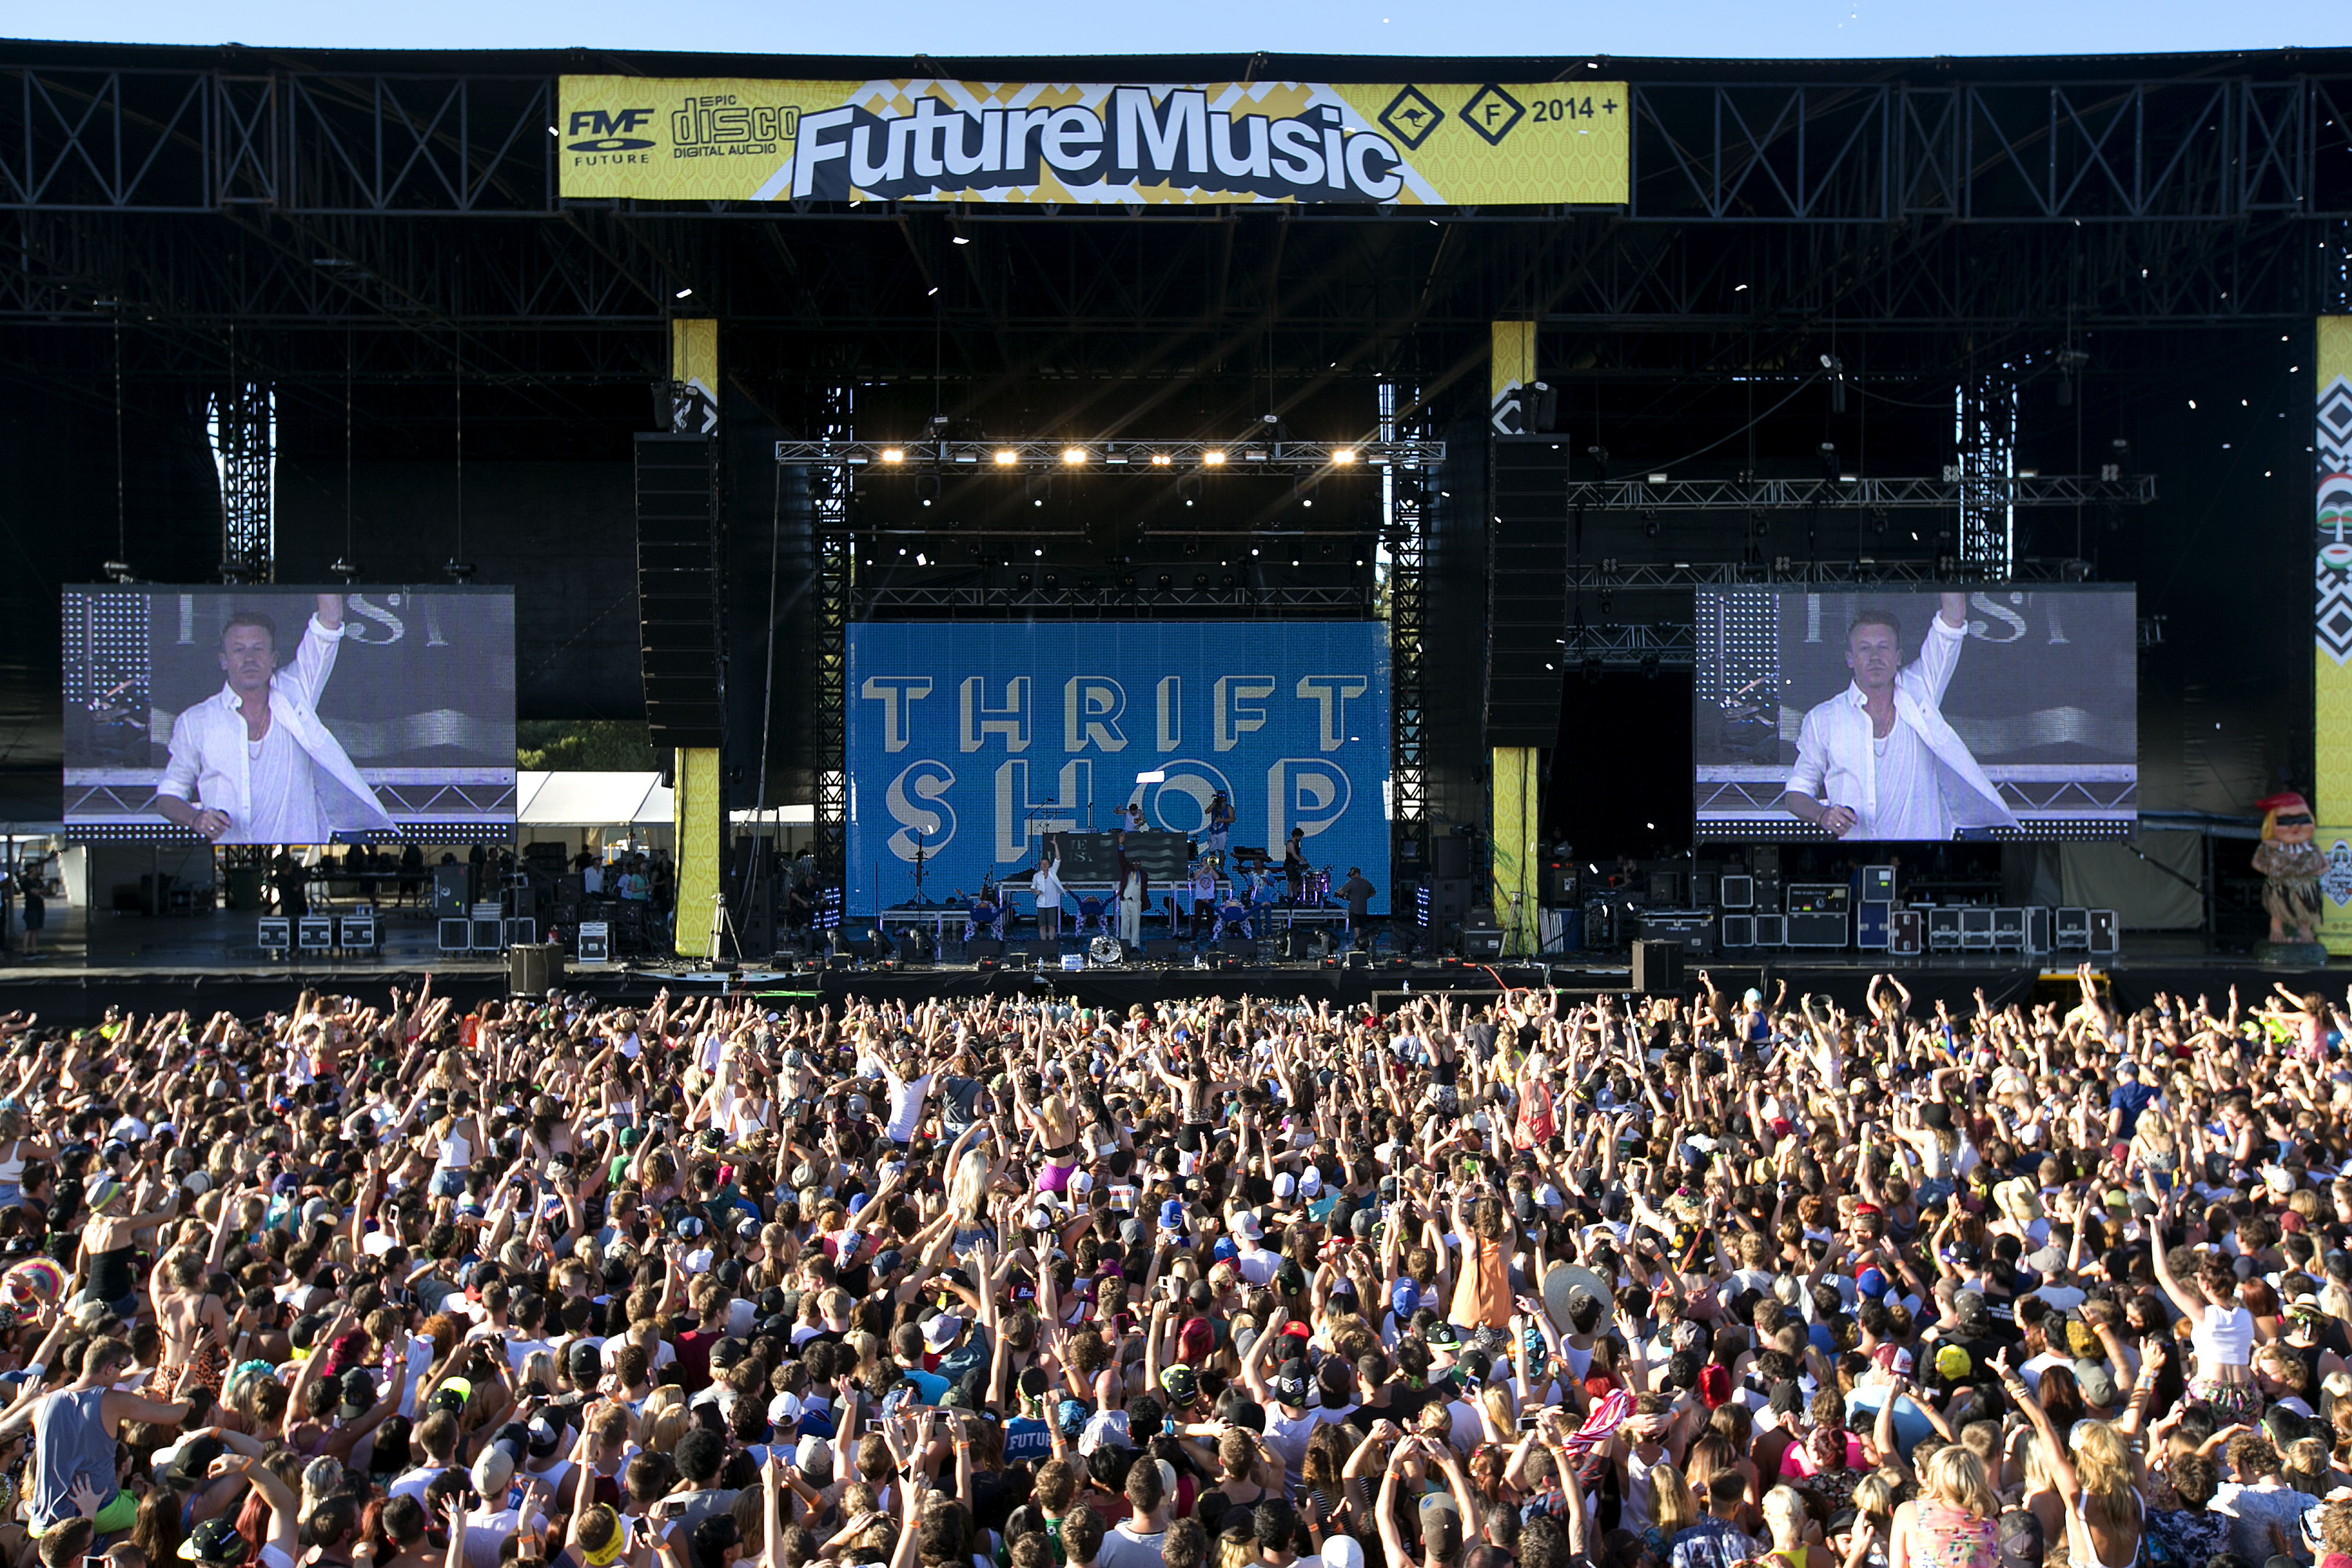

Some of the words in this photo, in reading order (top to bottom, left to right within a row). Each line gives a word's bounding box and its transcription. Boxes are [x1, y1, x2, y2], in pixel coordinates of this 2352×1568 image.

[700, 95, 736, 106] EPIC
[1532, 96, 1594, 122] 2014
[569, 109, 655, 137] FMF
[1484, 103, 1501, 126] F
[574, 154, 649, 167] FUTURE
[673, 146, 724, 158] DIGITAL
[729, 143, 776, 155] AUDIO
[862, 676, 1367, 752] THRIFT
[886, 758, 1351, 862] SHOP
[1008, 1432, 1051, 1450] FUTUR
